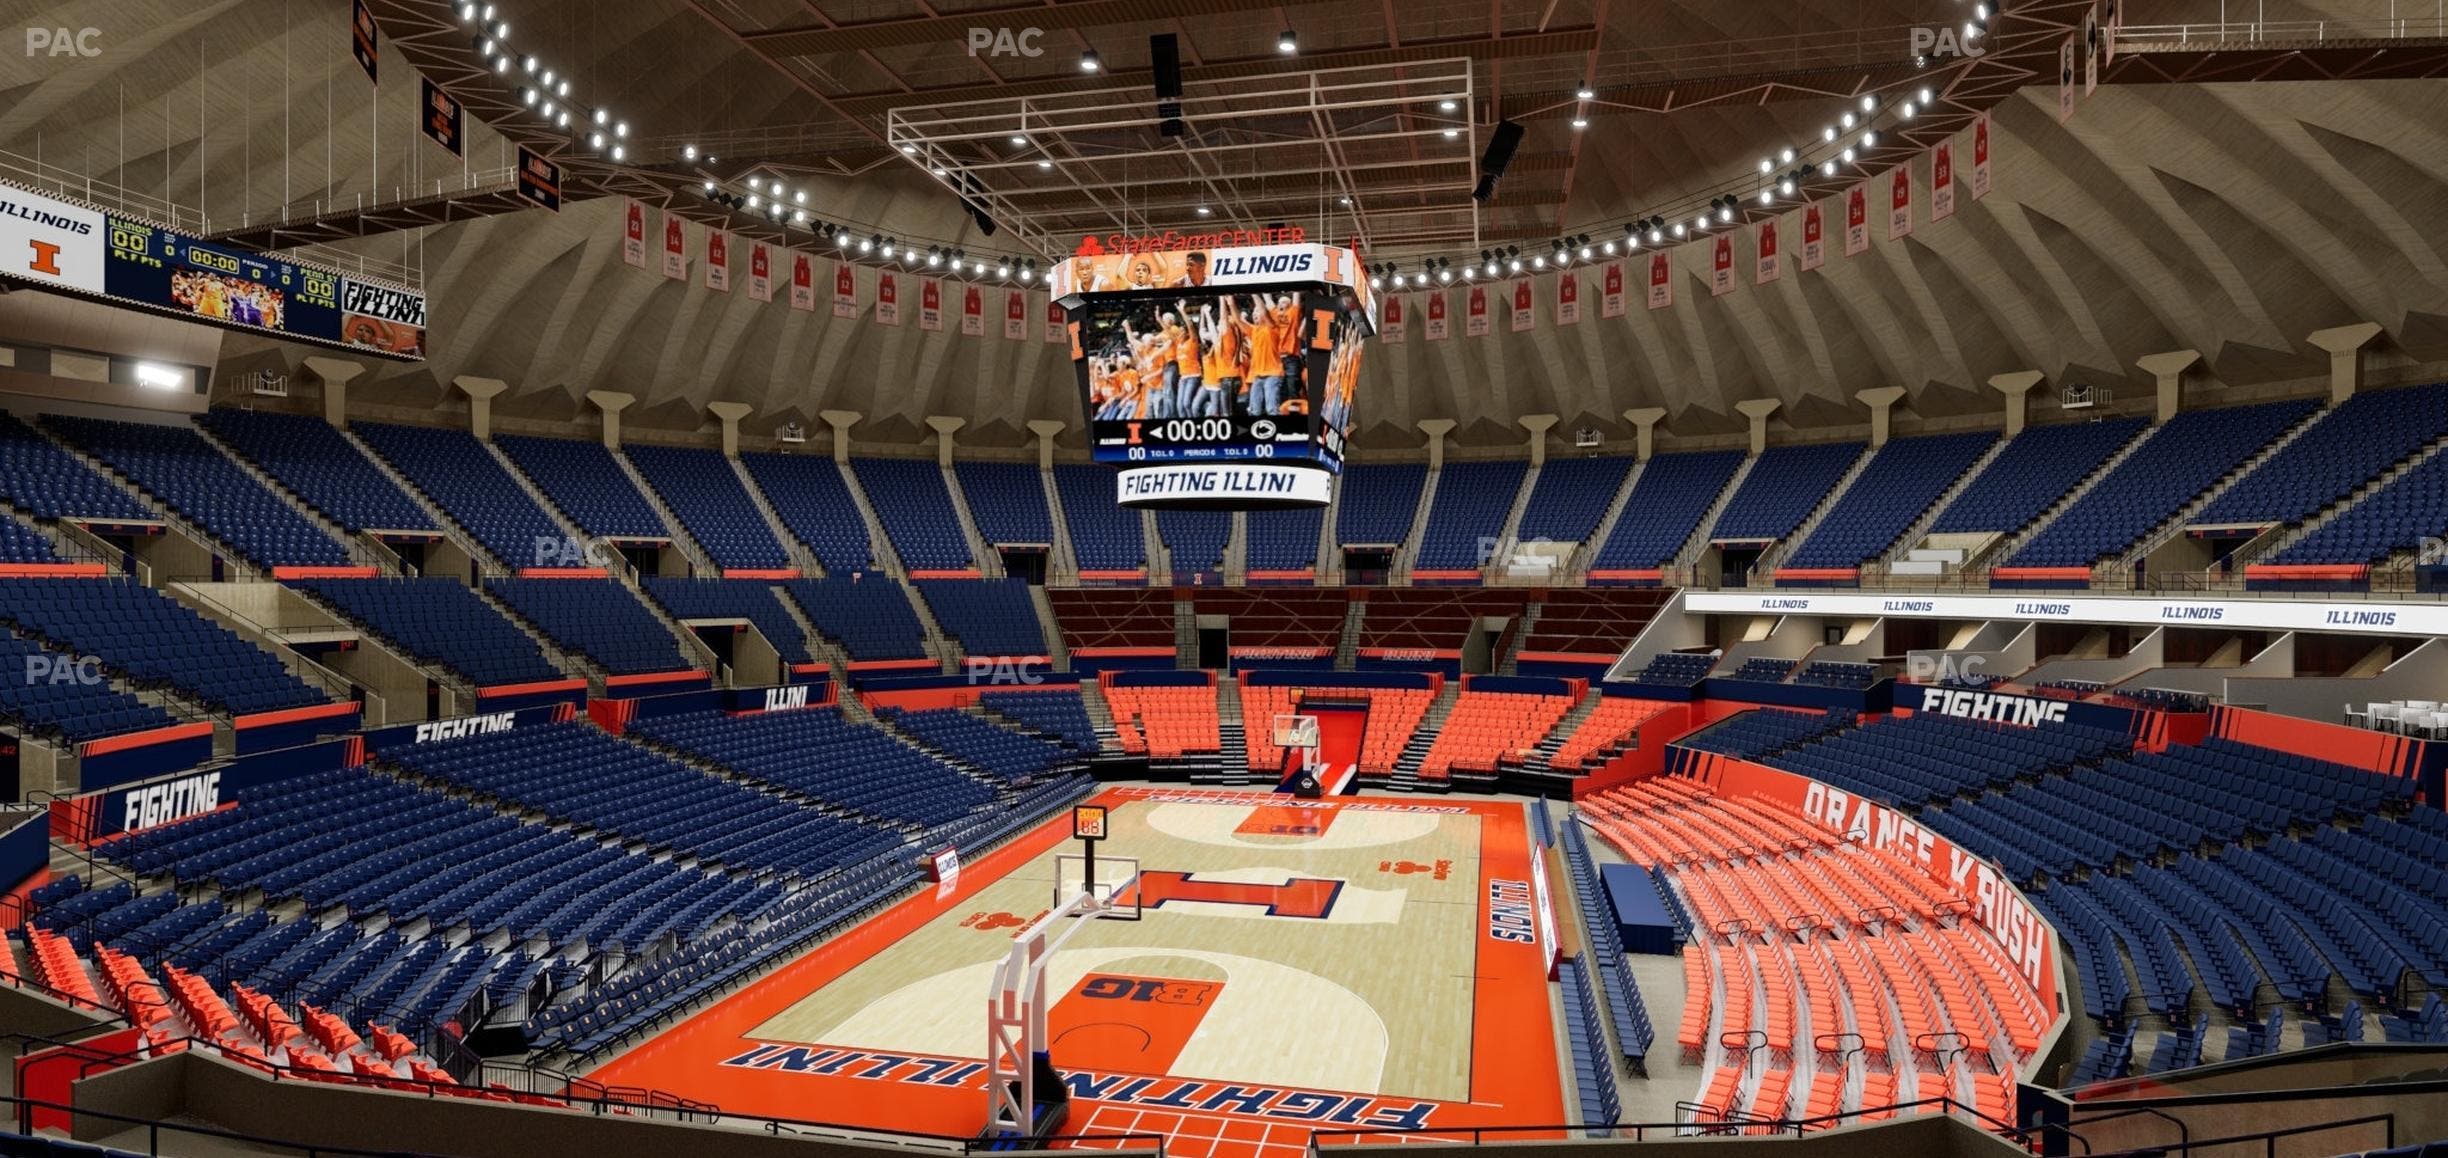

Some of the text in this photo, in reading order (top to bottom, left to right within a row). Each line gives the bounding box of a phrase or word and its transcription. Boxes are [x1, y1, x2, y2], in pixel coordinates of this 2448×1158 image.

[109, 217, 152, 236] ILLINOIS
[113, 231, 144, 251] 00
[165, 245, 175, 256] 0
[30, 239, 60, 276] I
[141, 255, 162, 268] PTS
[192, 250, 237, 271] 00:00
[1214, 253, 1313, 276] ILLINOIS
[1324, 247, 1344, 283] I
[252, 269, 261, 279] 0
[282, 276, 290, 285] 0
[307, 280, 332, 297] 00
[345, 280, 424, 310] FIGHTING
[1311, 309, 1335, 350] I
[1167, 419, 1231, 442] 00:00
[1129, 447, 1145, 460] 00
[1256, 444, 1273, 458] 00
[1125, 472, 1296, 495] FIGHTING ILLINI
[1761, 599, 1808, 609] ILLINOIS
[1884, 601, 1933, 612] ILLINOIS
[2015, 603, 2070, 615] ILLINOIS
[2162, 606, 2223, 620] ILLINOIS
[2326, 610, 2396, 626] ILLINOIS
[765, 685, 808, 712] ILLINI
[1921, 688, 2069, 728] FIGHTING
[415, 712, 516, 744] FIGHTING
[124, 771, 221, 833] FIGHTING
[1802, 781, 2045, 993] ORANGE KRUSH
[1490, 878, 1536, 944] ILLINOIS
[718, 1043, 1440, 1131] FIGHTIN ILLINI
